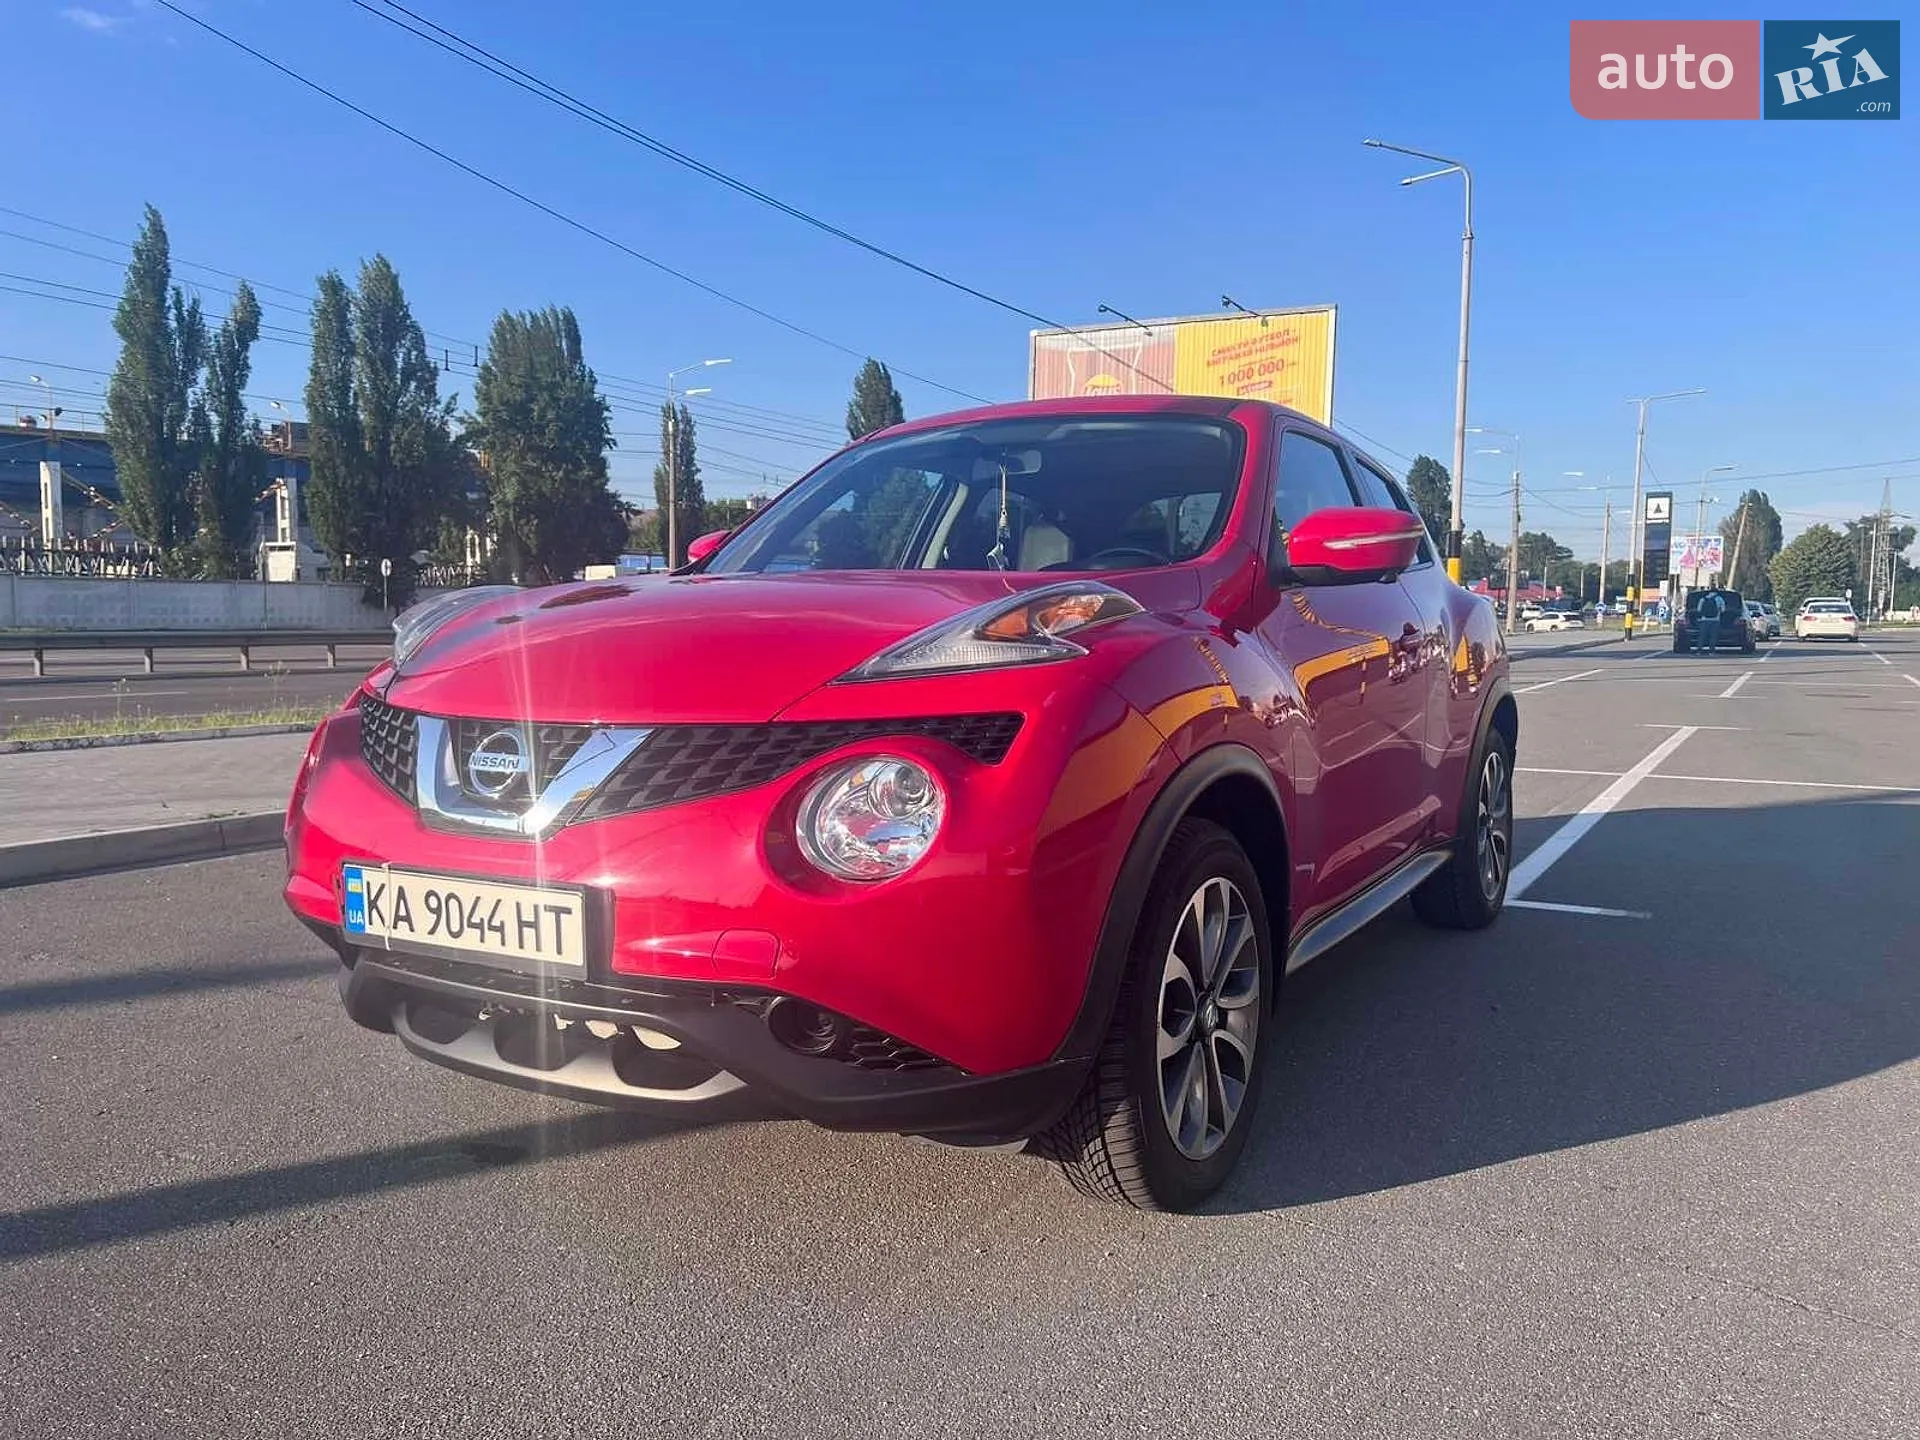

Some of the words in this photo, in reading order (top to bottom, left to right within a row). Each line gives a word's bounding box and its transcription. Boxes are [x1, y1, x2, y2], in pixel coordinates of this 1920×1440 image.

[470, 755, 520, 770] NISSAN
[349, 909, 365, 926] UA
[366, 881, 415, 933] KA
[424, 889, 506, 947] 9044
[515, 901, 573, 956] HT
